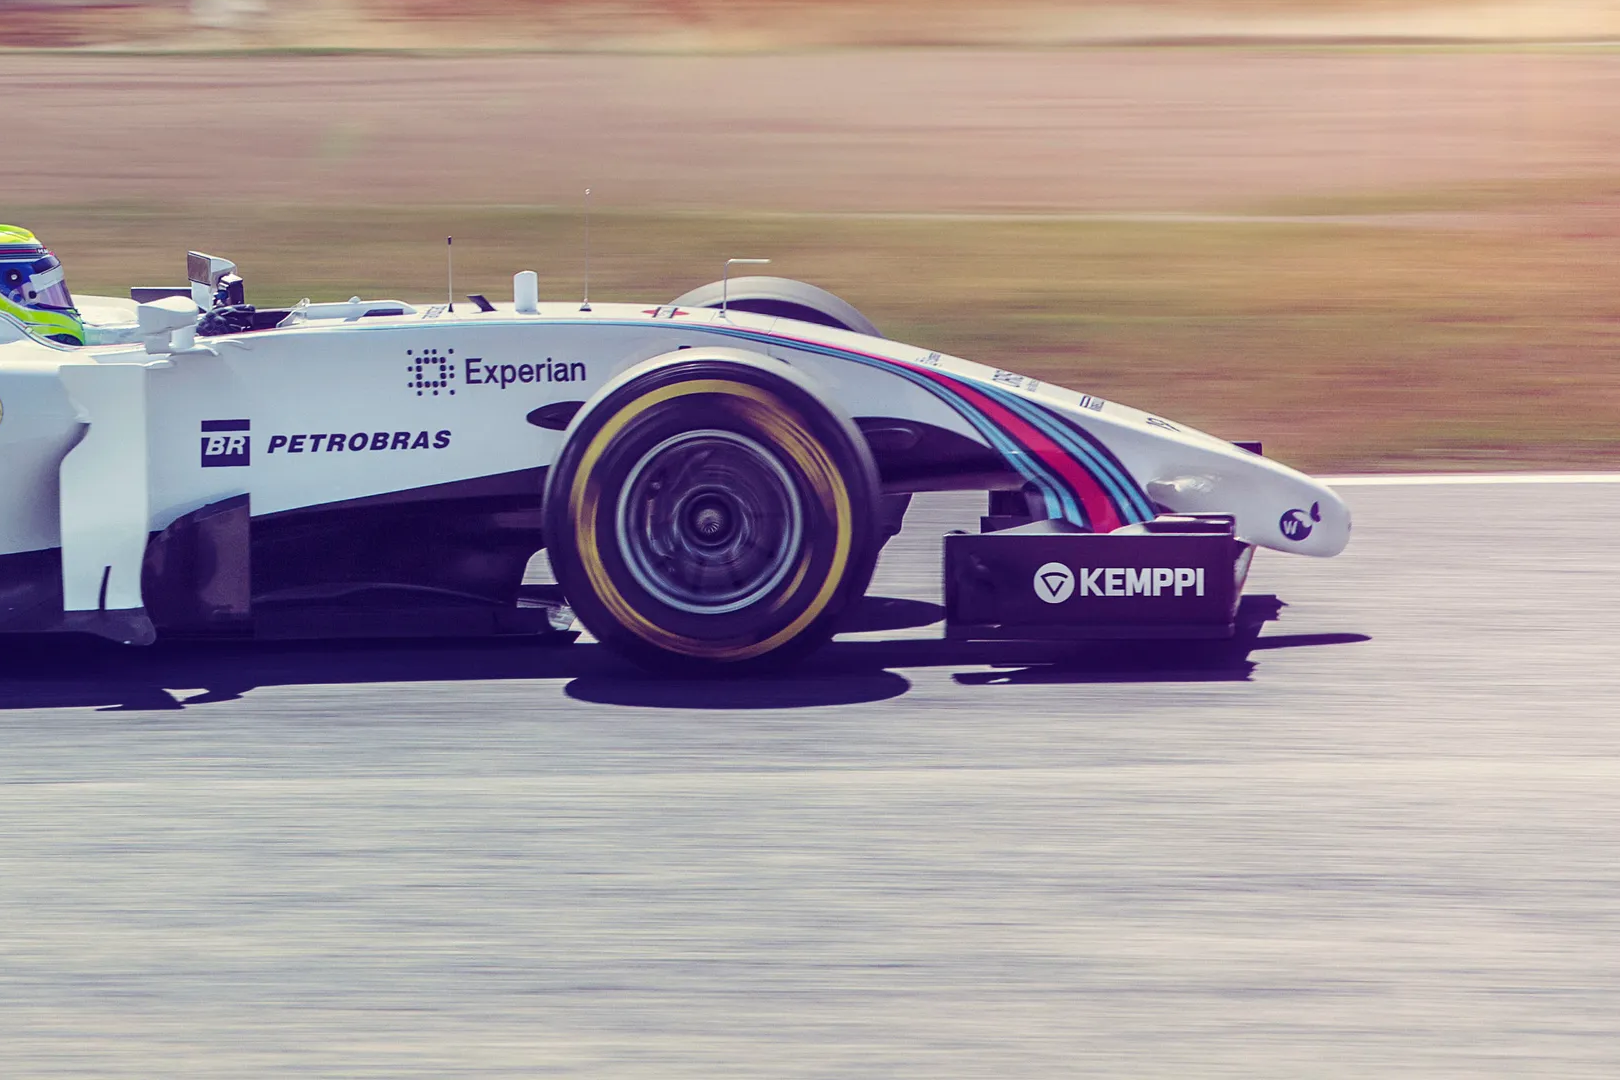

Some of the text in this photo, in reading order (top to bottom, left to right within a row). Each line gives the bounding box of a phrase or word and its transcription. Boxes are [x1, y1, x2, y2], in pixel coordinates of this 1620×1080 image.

[465, 357, 586, 389] Experian
[205, 430, 452, 456] BR PETROBRAS
[1080, 568, 1205, 597] KEMPPI
